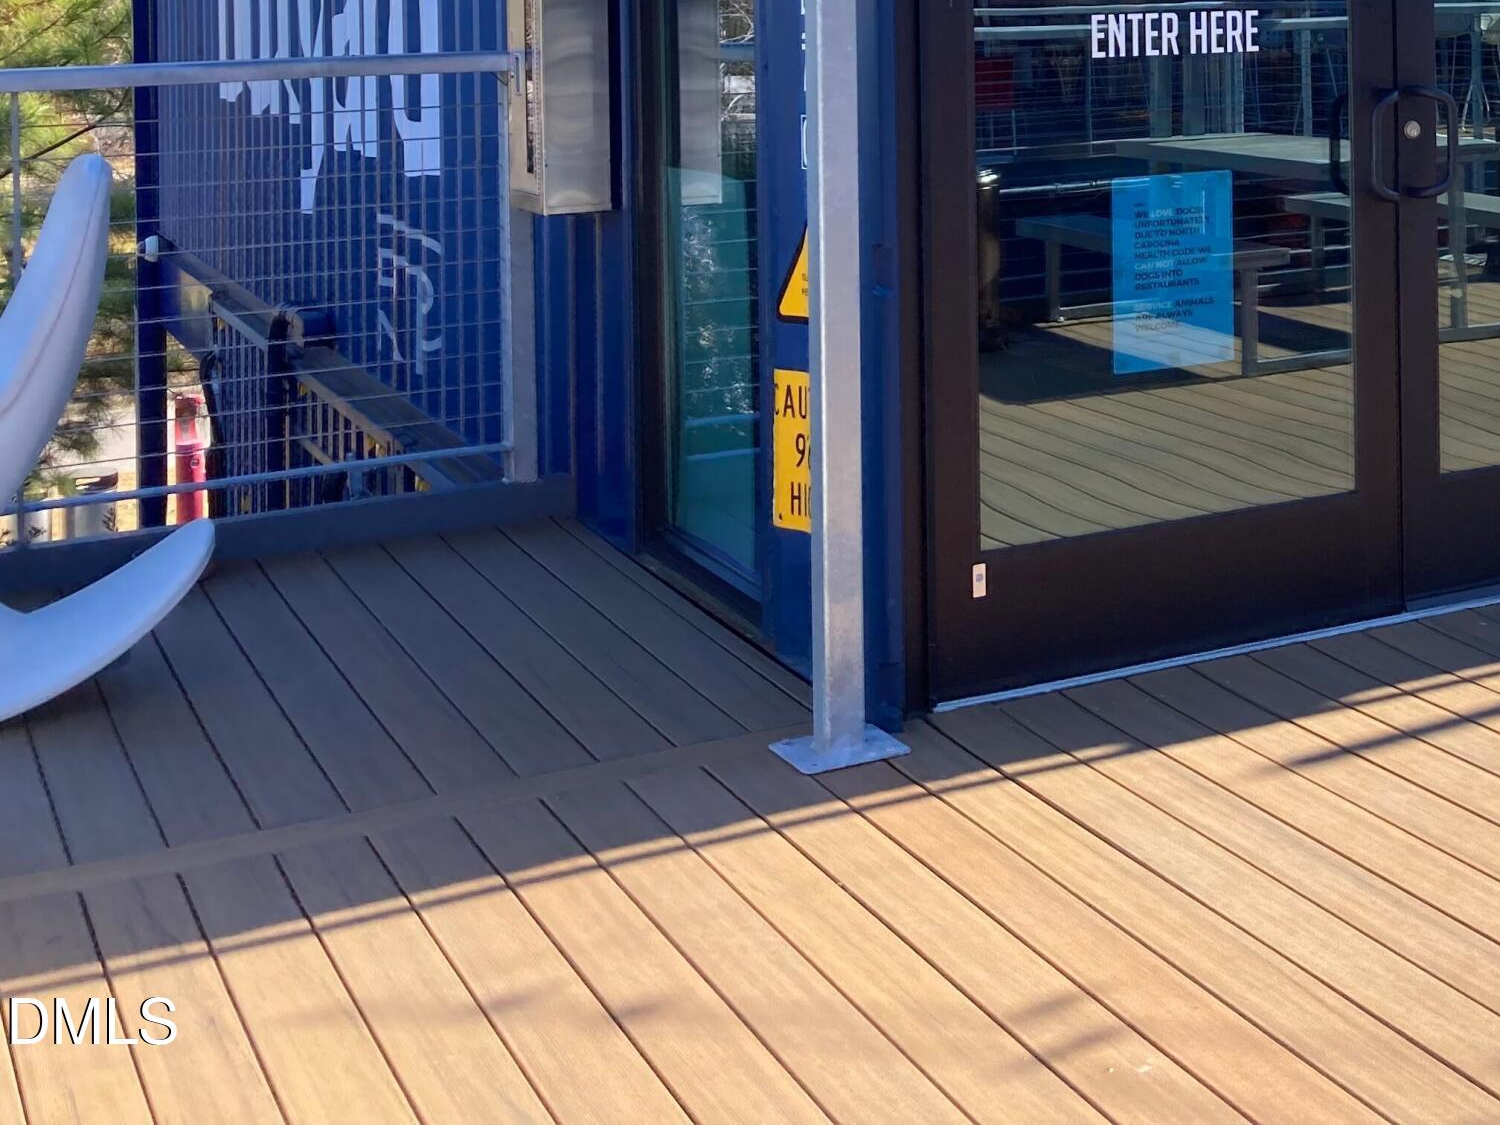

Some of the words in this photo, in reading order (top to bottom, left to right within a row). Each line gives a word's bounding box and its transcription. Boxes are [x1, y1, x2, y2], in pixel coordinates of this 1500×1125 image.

[1091, 11, 1180, 59] ENTER
[1190, 9, 1260, 55] HERE
[1150, 208, 1174, 217] LOVE
